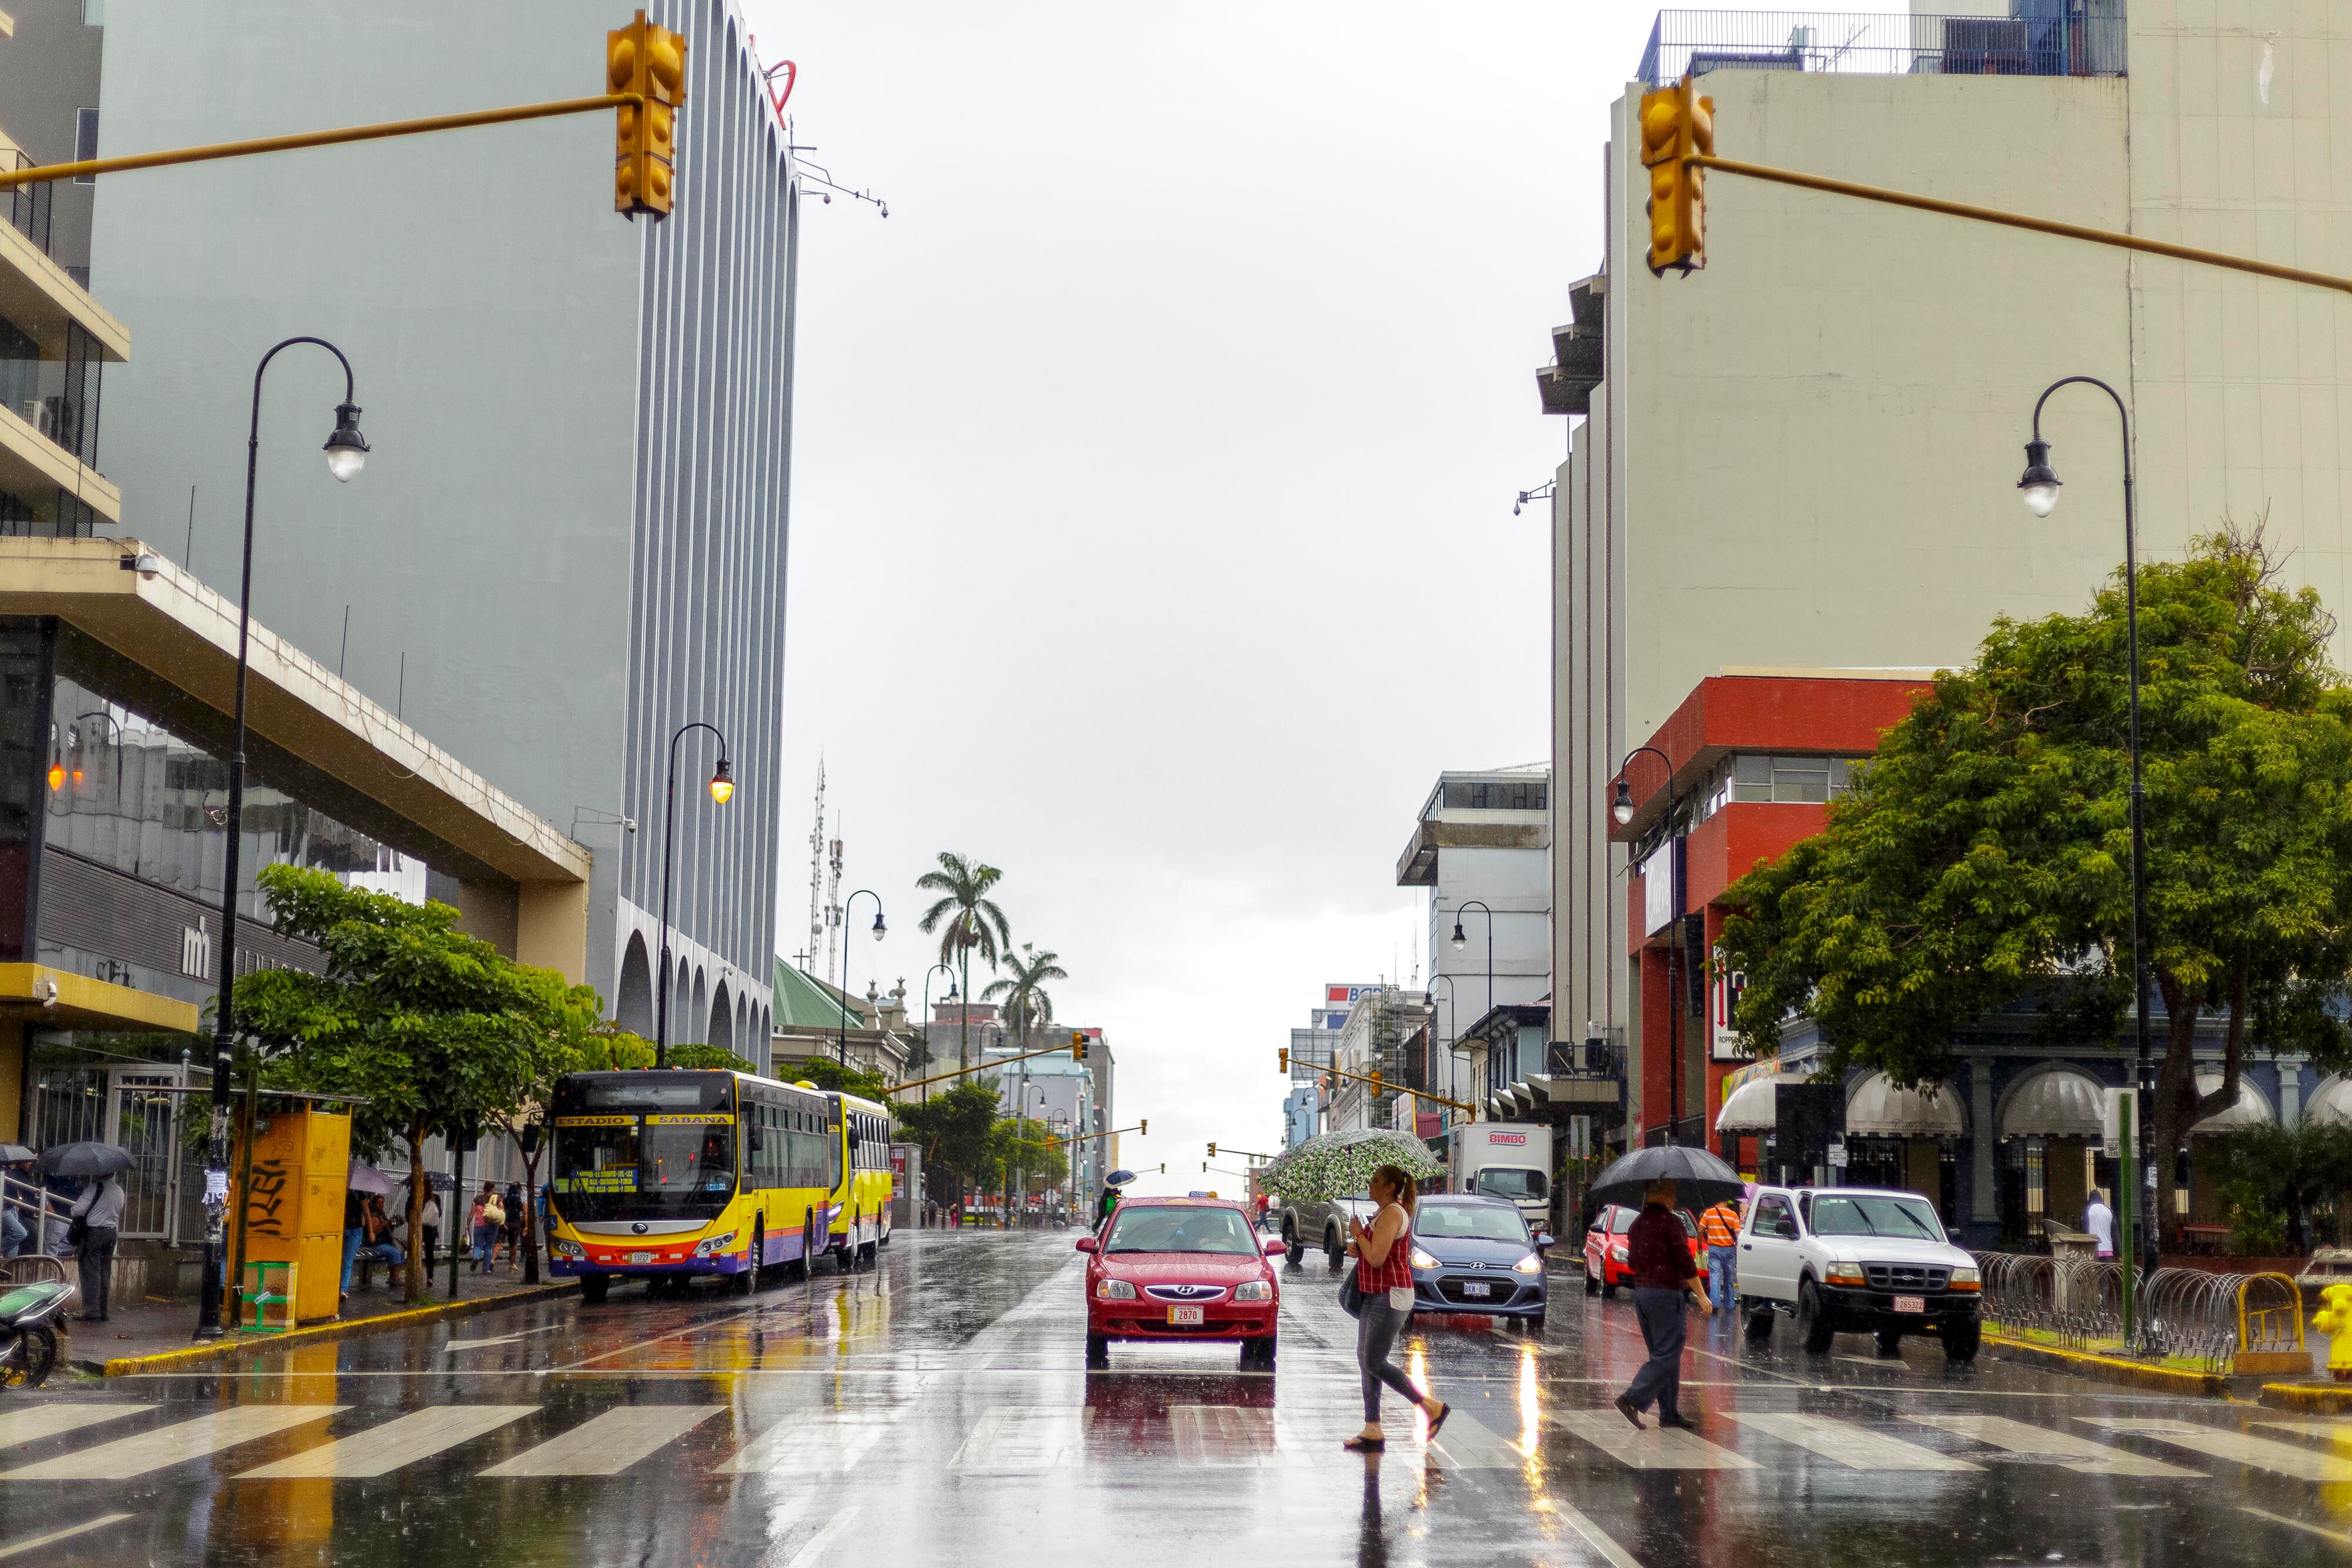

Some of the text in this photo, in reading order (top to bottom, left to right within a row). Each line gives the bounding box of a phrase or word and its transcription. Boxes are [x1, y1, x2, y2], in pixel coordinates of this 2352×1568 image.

[1489, 1134, 1526, 1144] BIMBO
[1900, 1300, 1923, 1309] 265322
[1178, 1310, 1197, 1320] 2870
